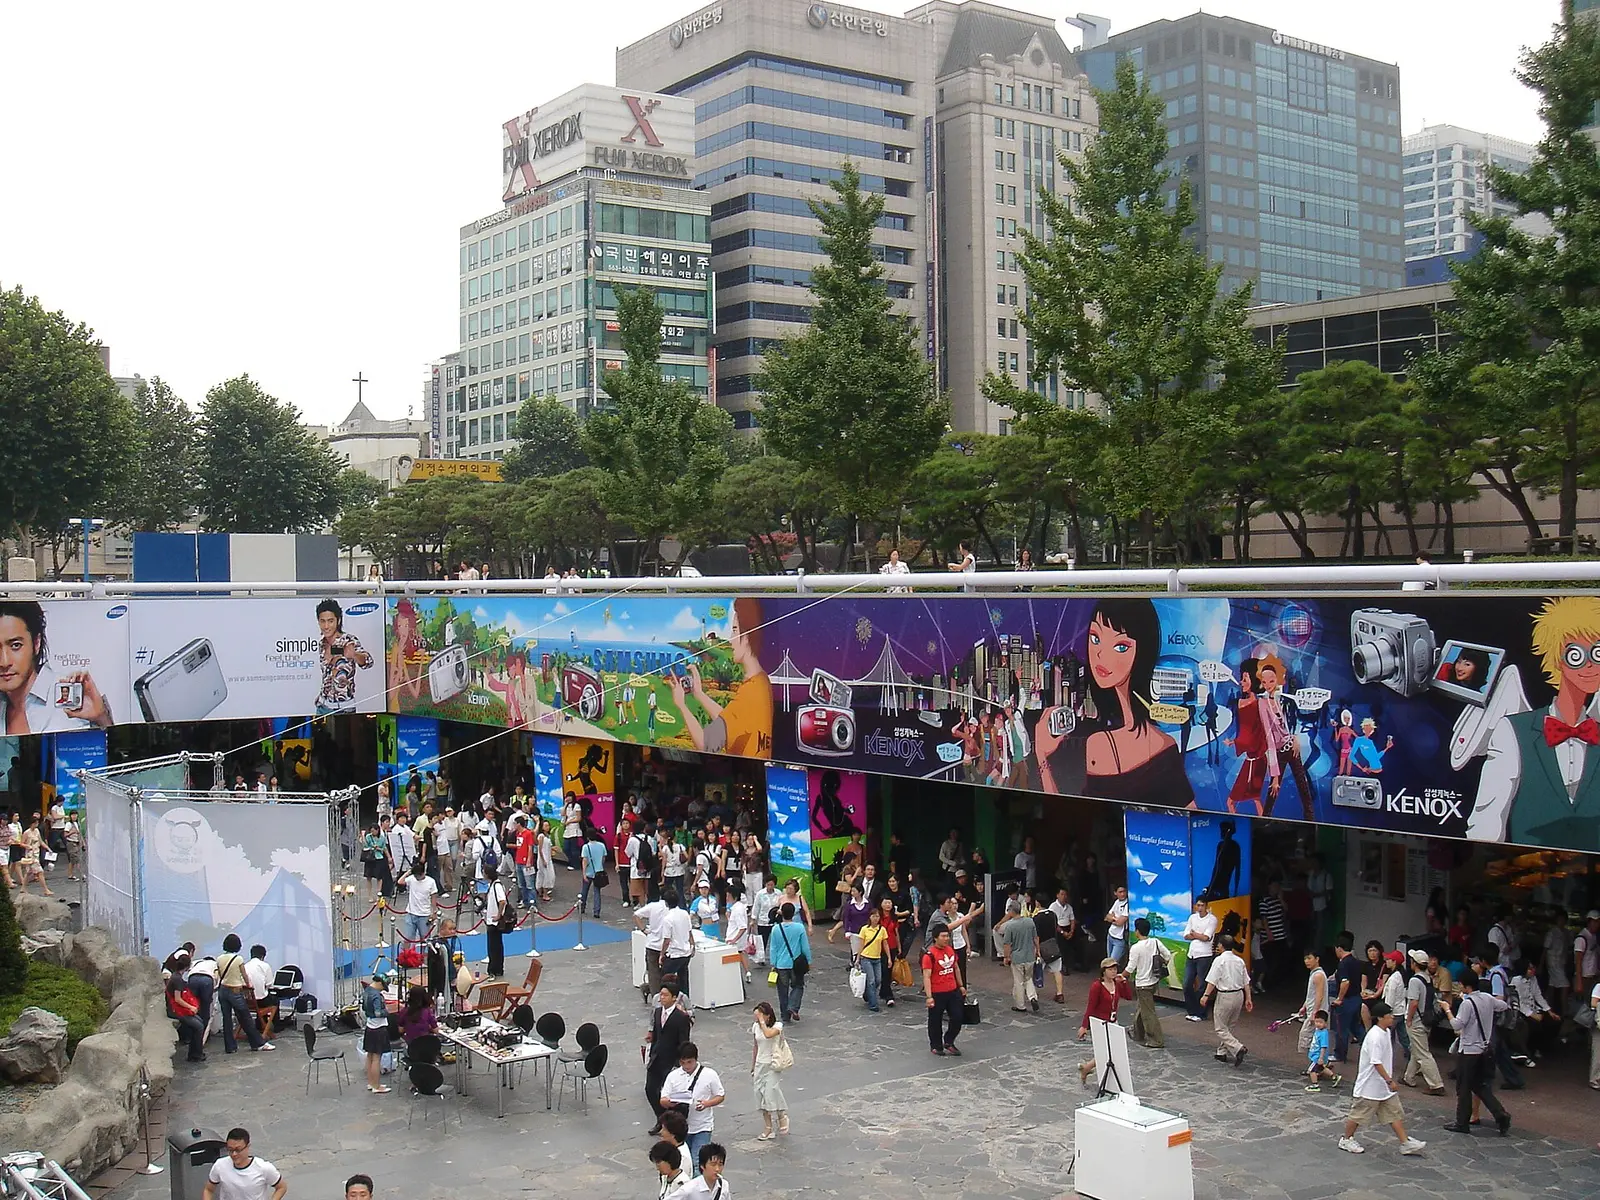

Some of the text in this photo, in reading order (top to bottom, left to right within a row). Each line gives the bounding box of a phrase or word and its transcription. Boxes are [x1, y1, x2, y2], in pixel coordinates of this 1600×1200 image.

[682, 6, 724, 39] 신한은행
[830, 10, 888, 37] 신한은행
[532, 111, 583, 160] XEROX
[594, 145, 689, 176] FUJI XEROX
[275, 637, 319, 656] simple
[1167, 630, 1204, 649] KENOX
[54, 653, 68, 661] feel
[61, 658, 91, 667] change
[134, 645, 156, 666] #1
[265, 653, 300, 662] feel the
[275, 659, 315, 670] change
[593, 647, 687, 676] SAMSUNG
[468, 690, 491, 709] KENOX
[864, 727, 925, 767] KENOX
[1386, 787, 1463, 825] KENOX
